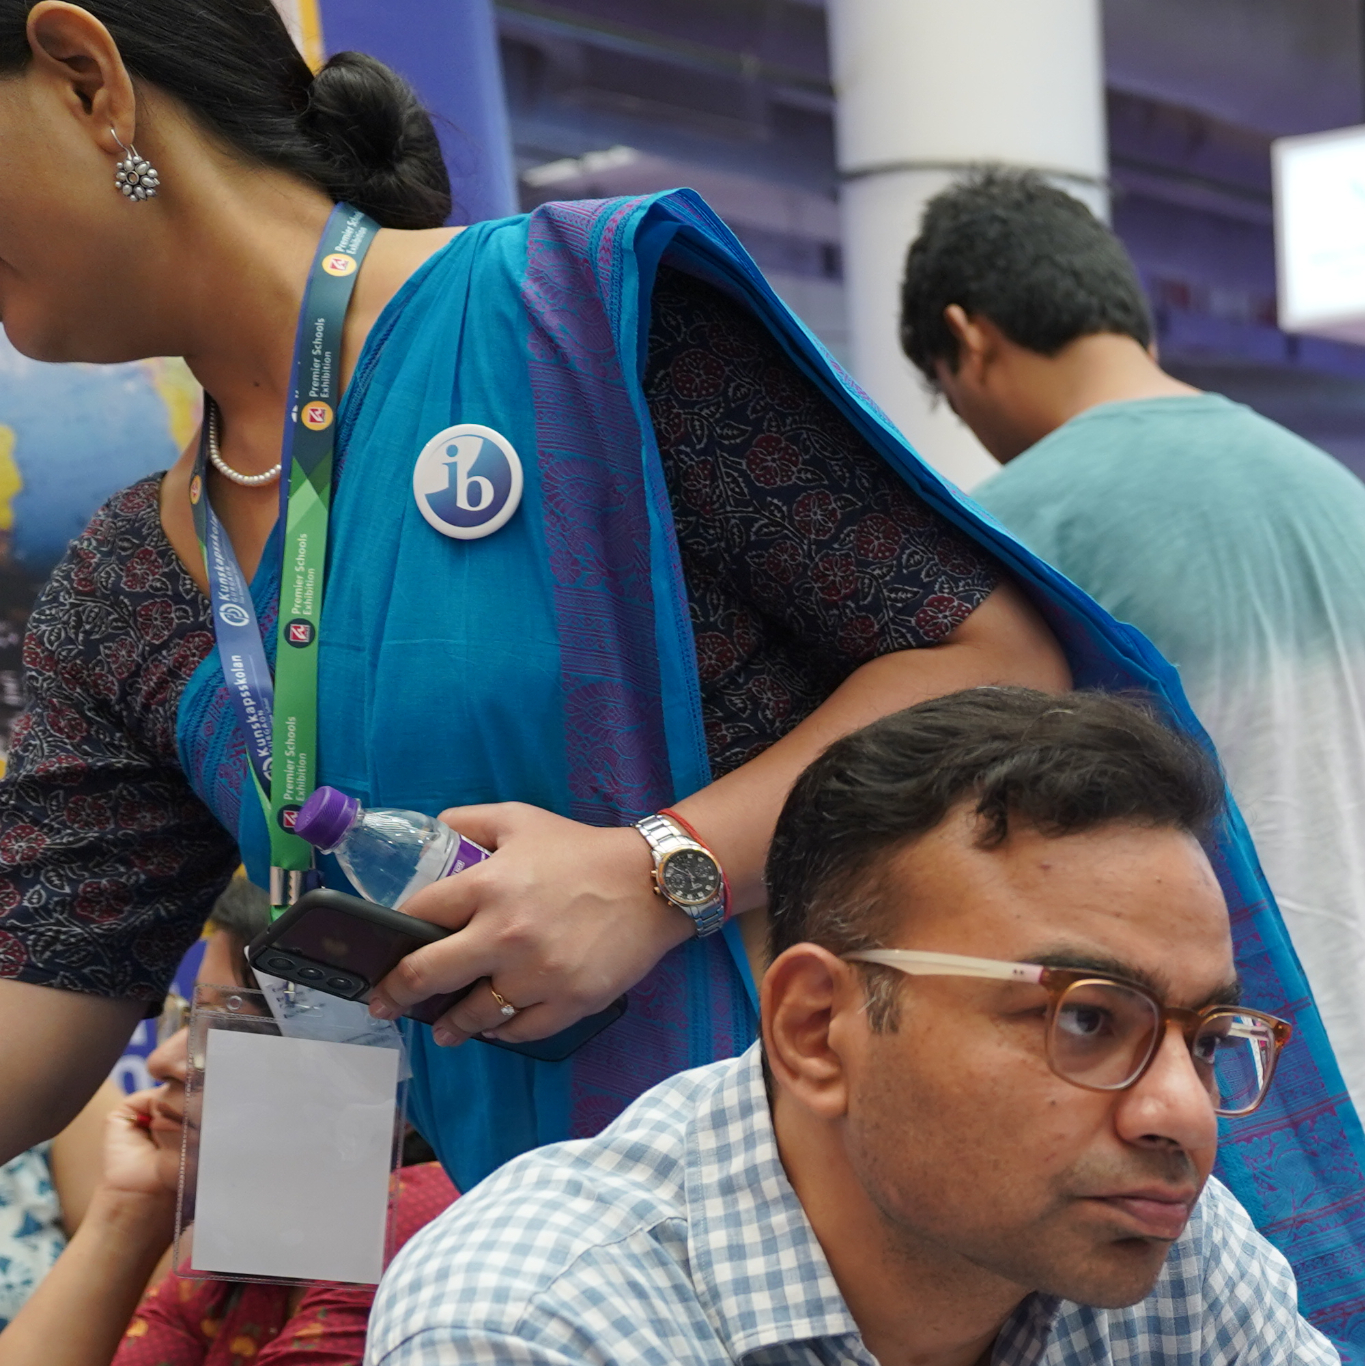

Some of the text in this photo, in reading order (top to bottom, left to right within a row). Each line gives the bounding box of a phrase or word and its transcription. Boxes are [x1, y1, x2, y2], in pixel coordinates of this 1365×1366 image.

[309, 318, 325, 397] Premier Schools
[320, 351, 332, 397] Exhibition
[292, 533, 307, 614] Premier Schools
[303, 568, 315, 615] Exhibition
[231, 655, 270, 757] Kunskapsskolan
[284, 716, 296, 800] Premier Schools
[296, 753, 307, 801] Exhibition
